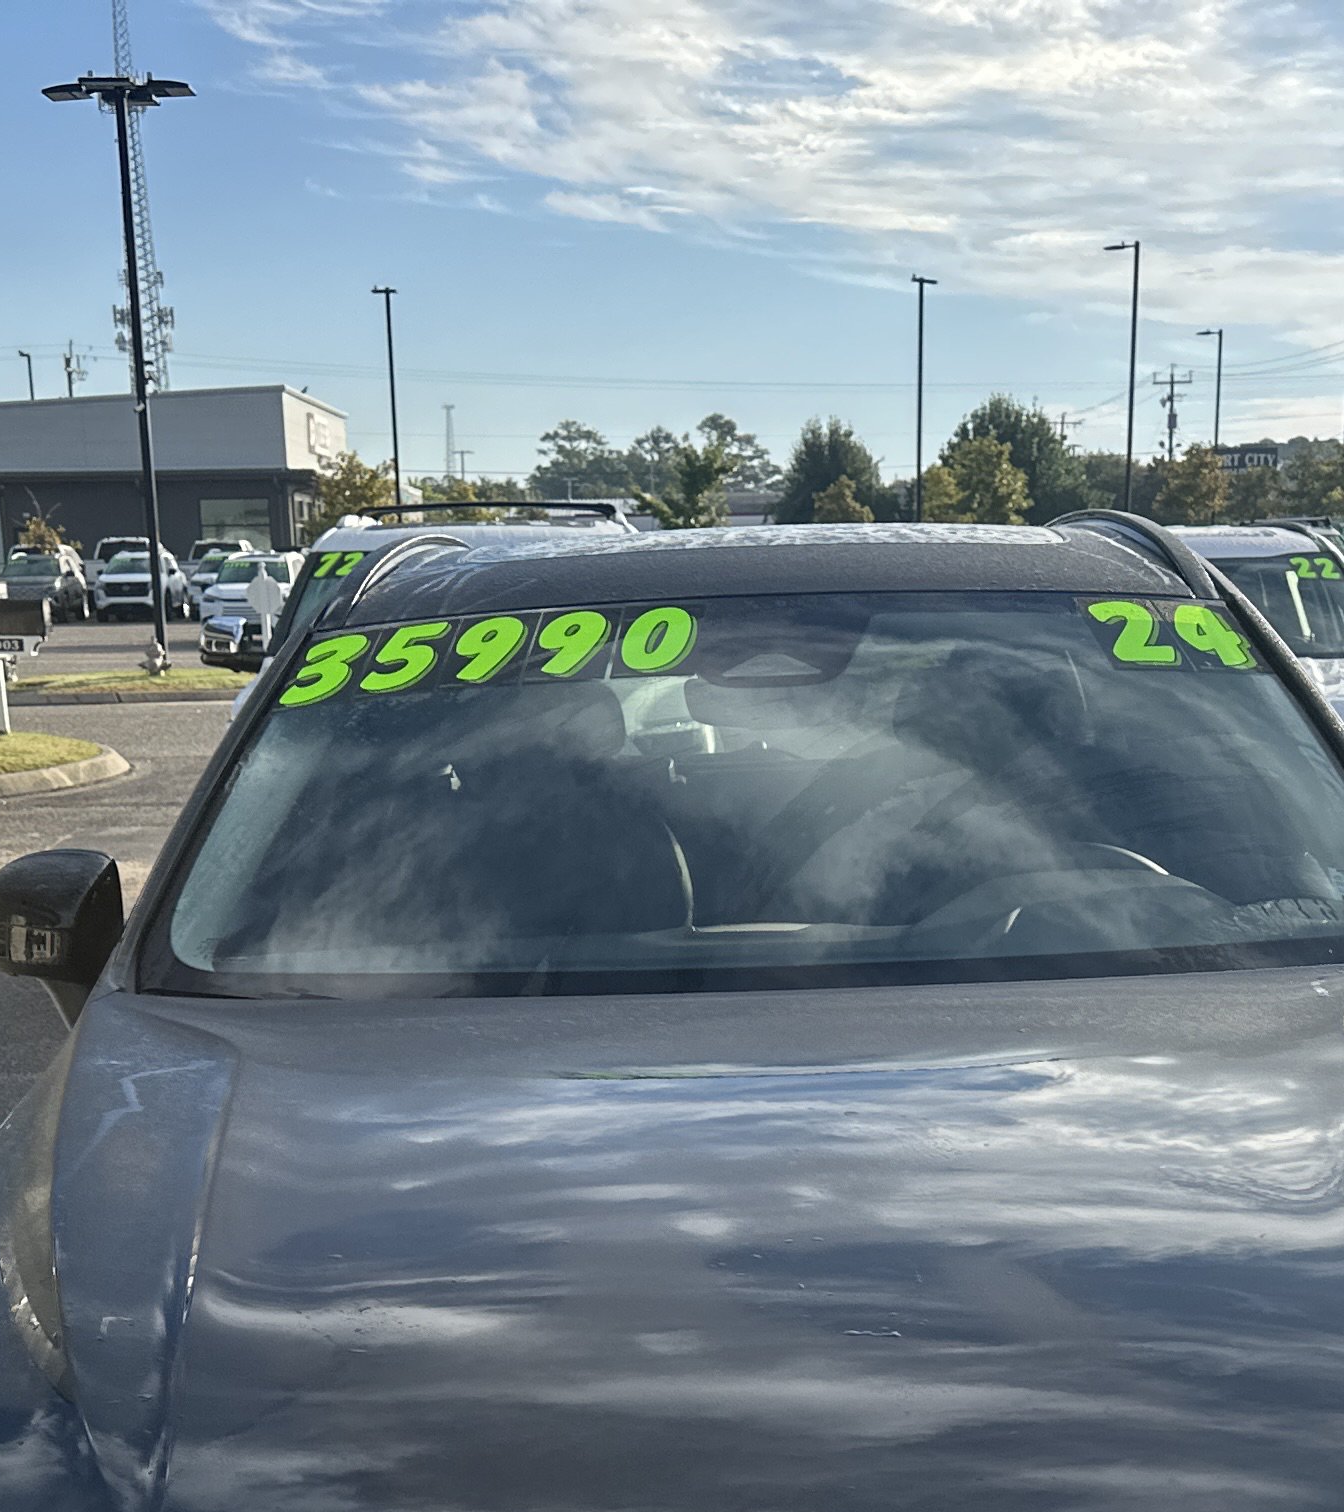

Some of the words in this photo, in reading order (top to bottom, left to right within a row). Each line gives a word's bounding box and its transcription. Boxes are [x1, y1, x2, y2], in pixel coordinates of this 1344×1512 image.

[1244, 453, 1276, 467] CITY
[1289, 556, 1341, 580] 22
[278, 606, 698, 708] 35990
[1087, 600, 1257, 670] 24
